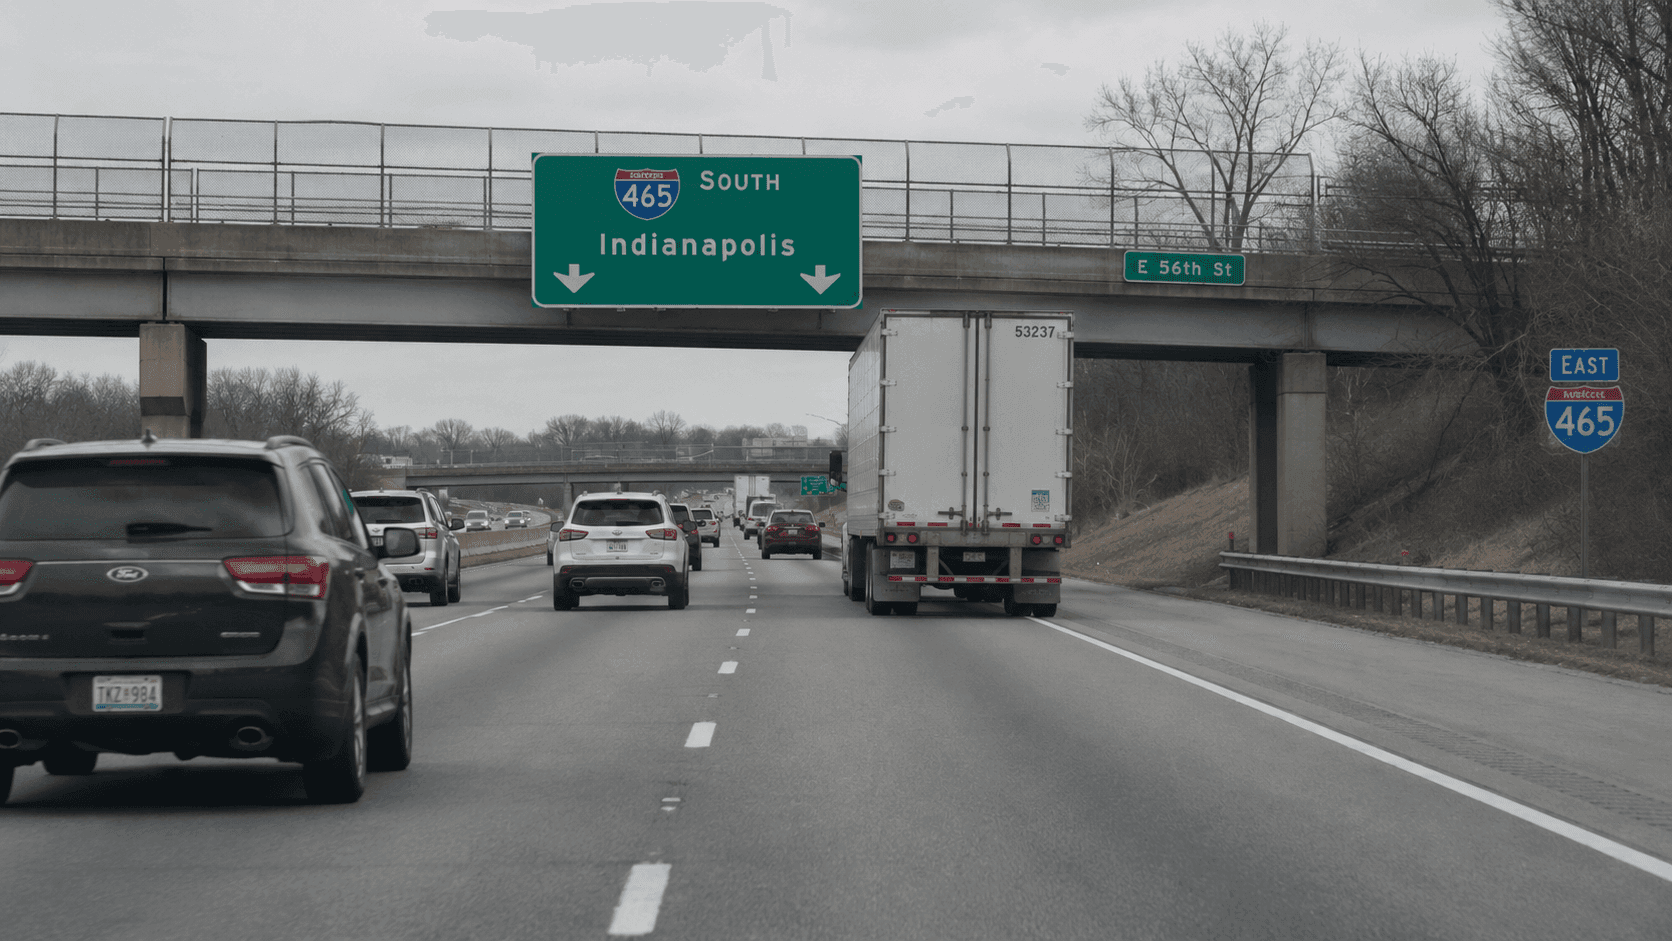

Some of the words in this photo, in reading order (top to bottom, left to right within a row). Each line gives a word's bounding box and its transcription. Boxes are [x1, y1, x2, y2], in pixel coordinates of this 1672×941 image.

[700, 170, 780, 191] SOUTH
[622, 184, 672, 208] 465
[600, 232, 795, 262] Indianapolis
[1138, 259, 1148, 274] E
[1159, 260, 1201, 276] 56th
[1213, 262, 1232, 277] St
[1015, 325, 1056, 339] 53237
[1562, 355, 1608, 374] EAST
[1555, 406, 1615, 437] 465
